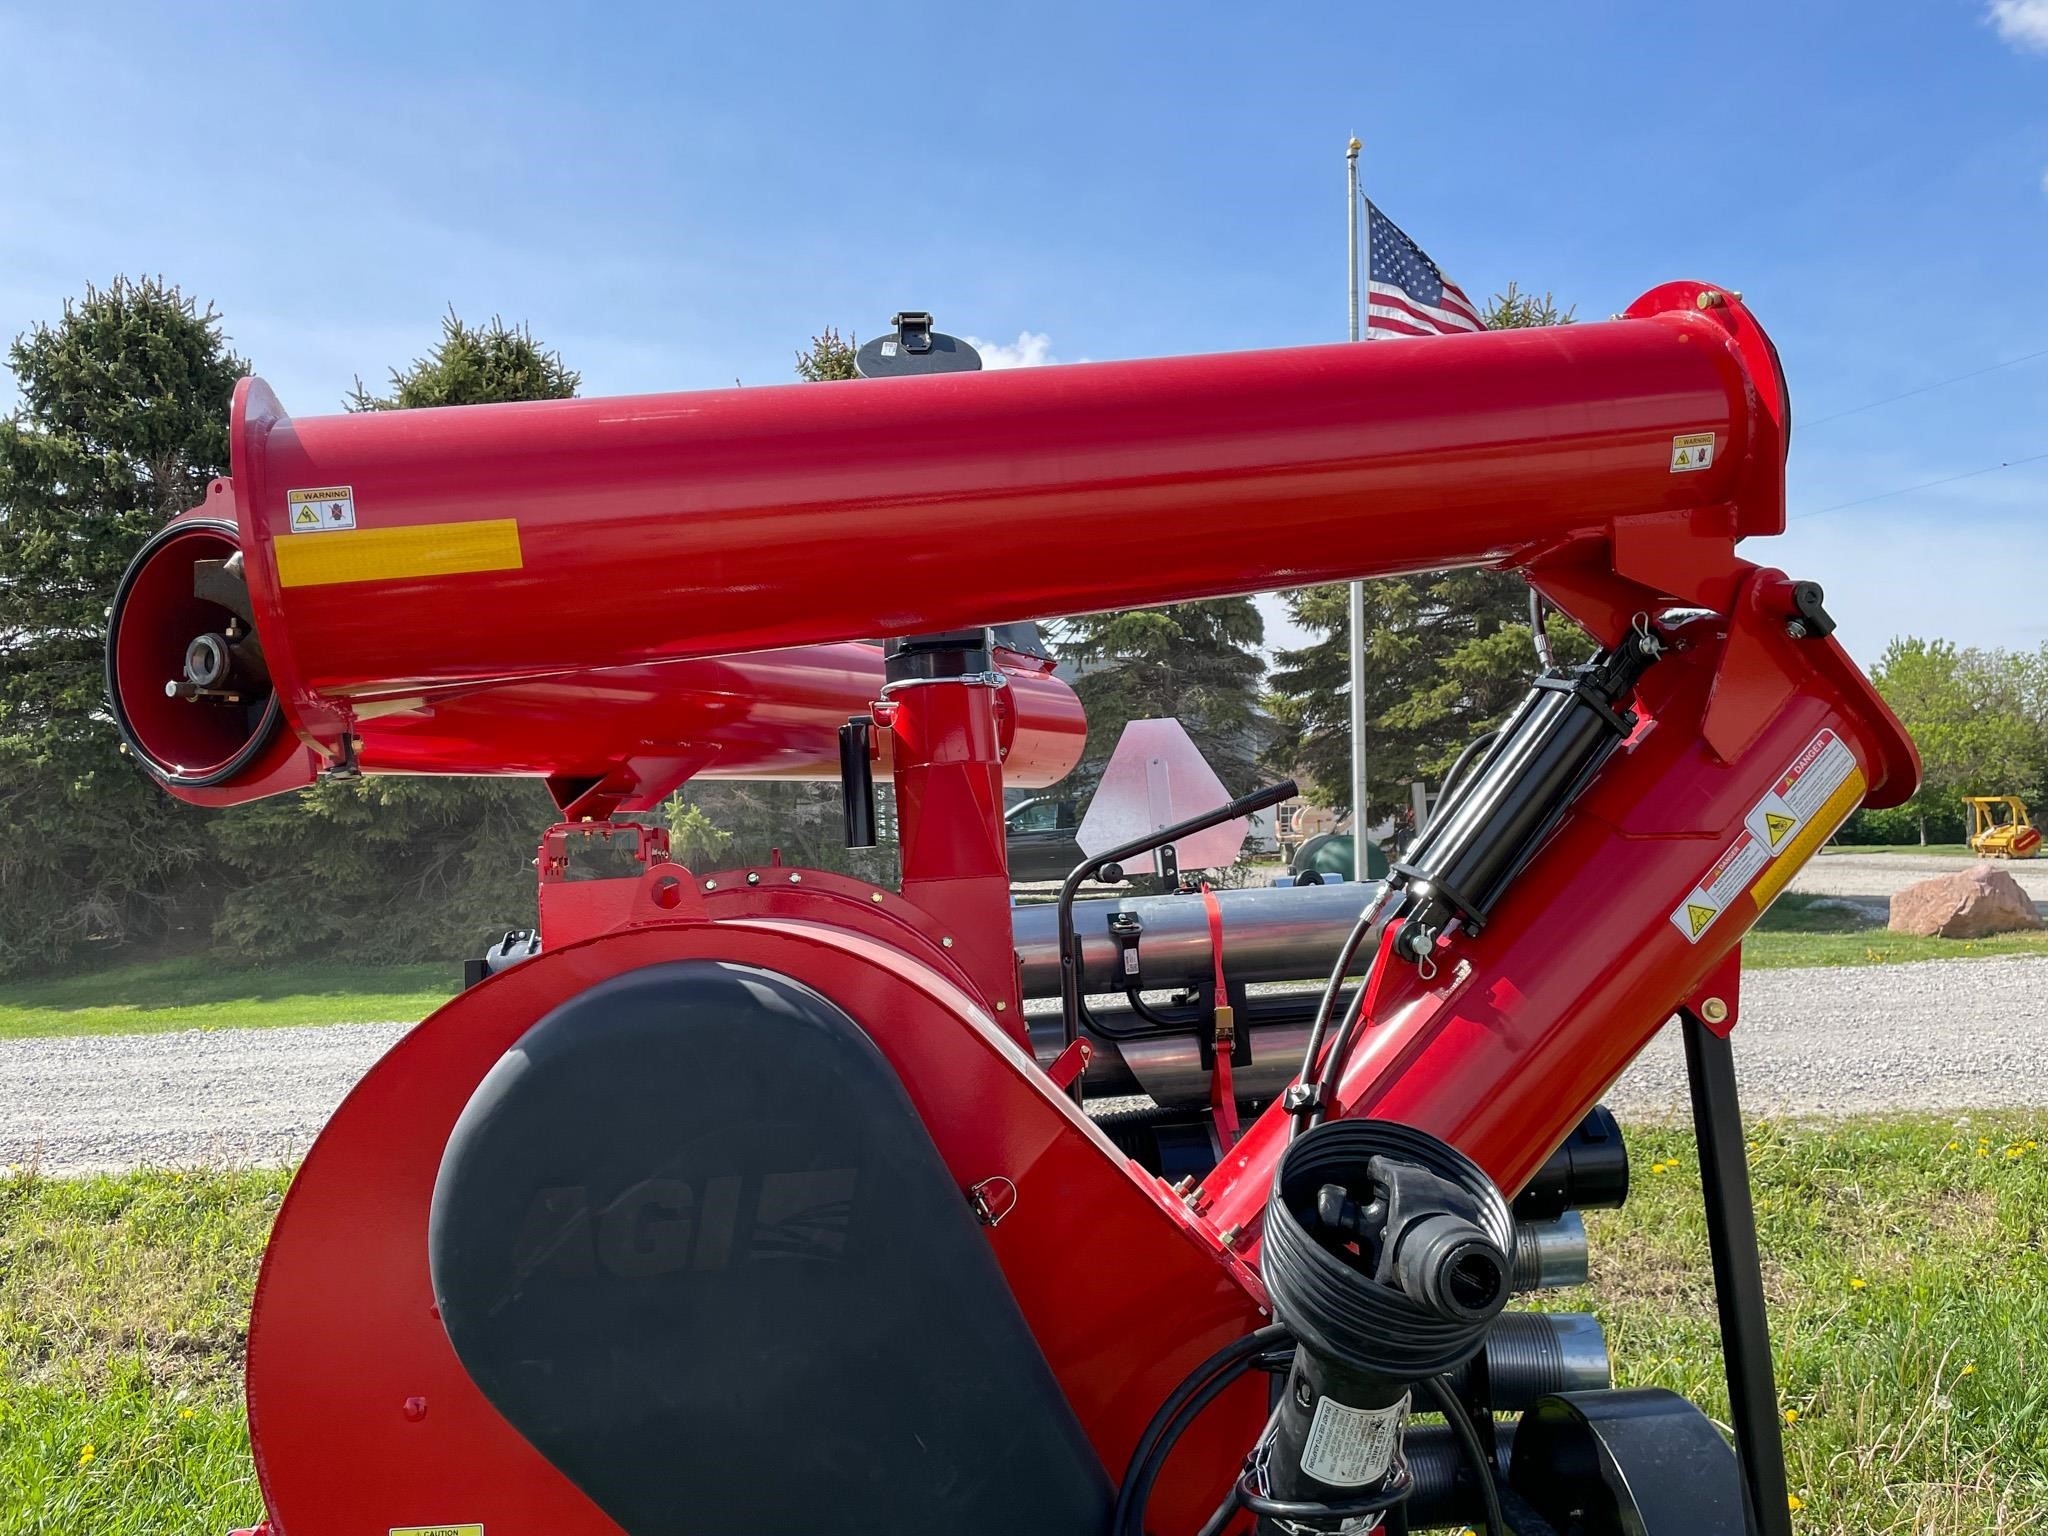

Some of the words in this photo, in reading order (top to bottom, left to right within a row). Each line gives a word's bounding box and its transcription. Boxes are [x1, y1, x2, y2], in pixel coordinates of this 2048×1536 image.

[1683, 436, 1711, 445] WARNING
[304, 491, 347, 500] WARNING
[1794, 739, 1825, 775] DANGER
[1718, 846, 1741, 871] DANGER
[512, 1175, 743, 1277] AGI
